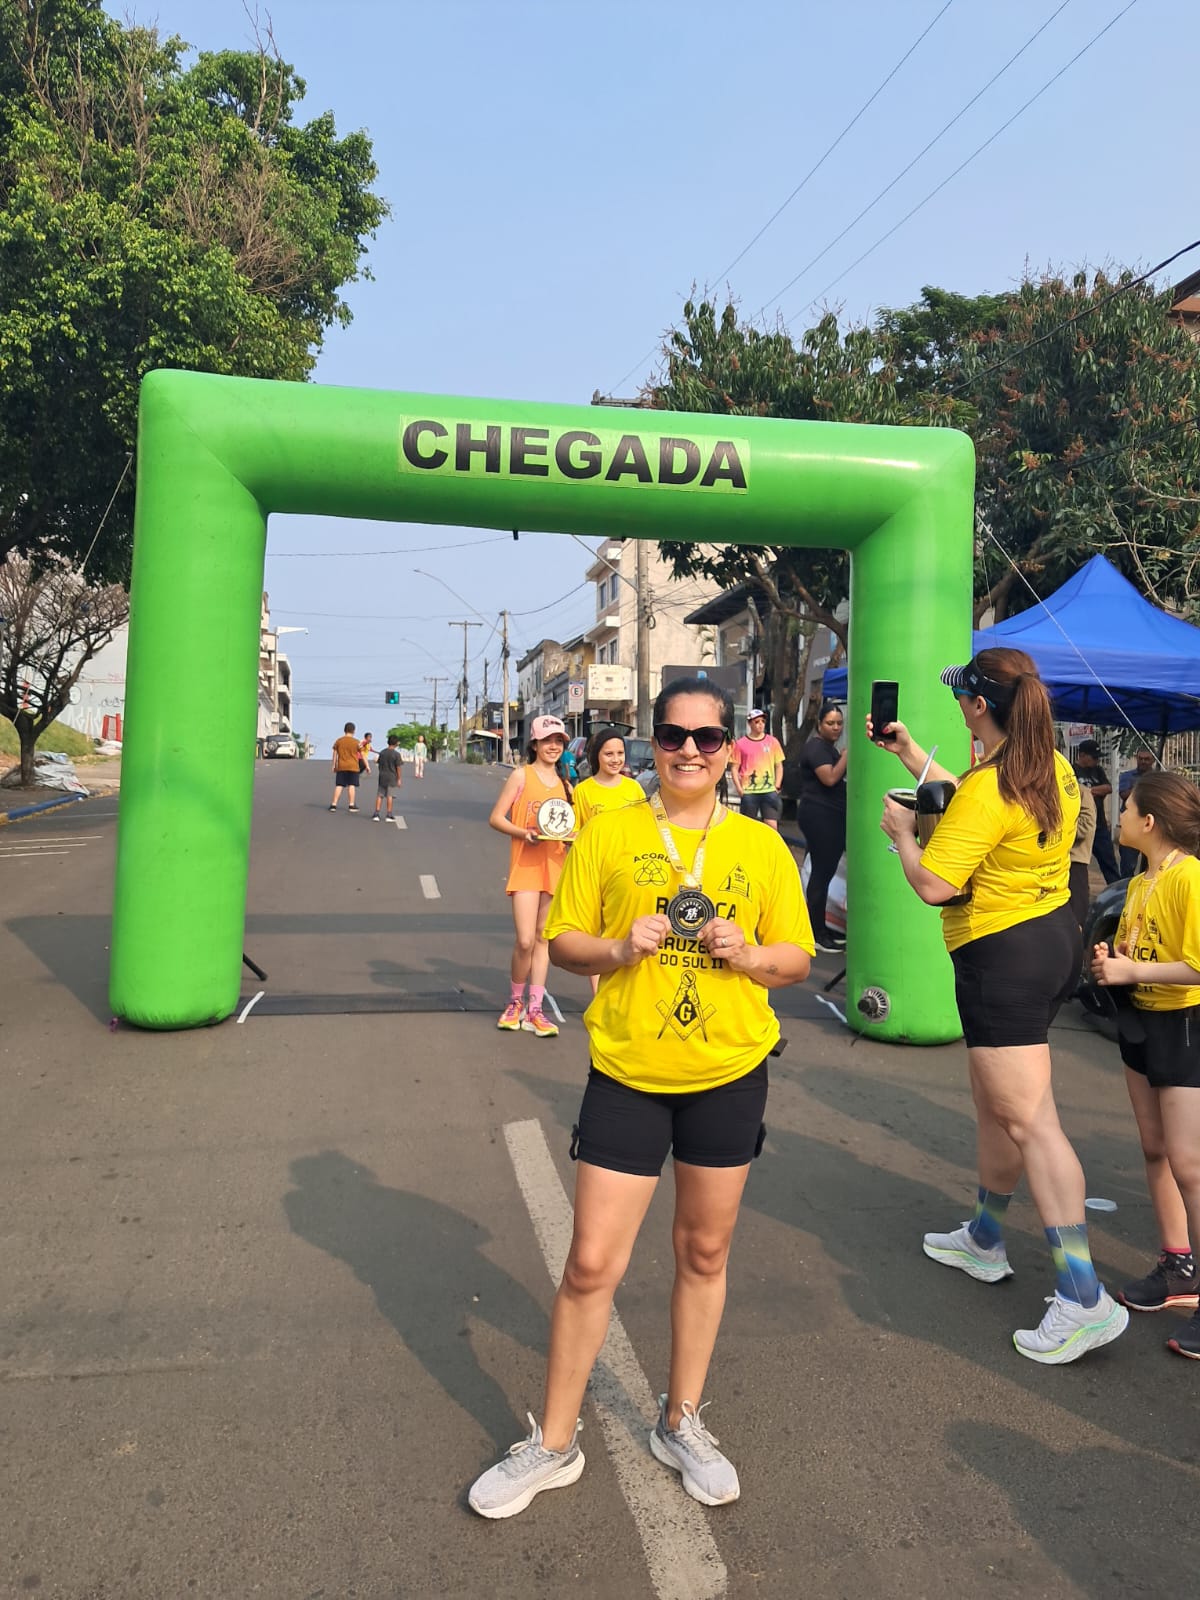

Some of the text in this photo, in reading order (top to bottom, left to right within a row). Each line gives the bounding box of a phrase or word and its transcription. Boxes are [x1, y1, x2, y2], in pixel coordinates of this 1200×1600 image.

[402, 420, 747, 489] CHEGADA
[573, 687, 580, 696] E
[660, 953, 723, 970] DO SUL II
[680, 1002, 693, 1022] G
